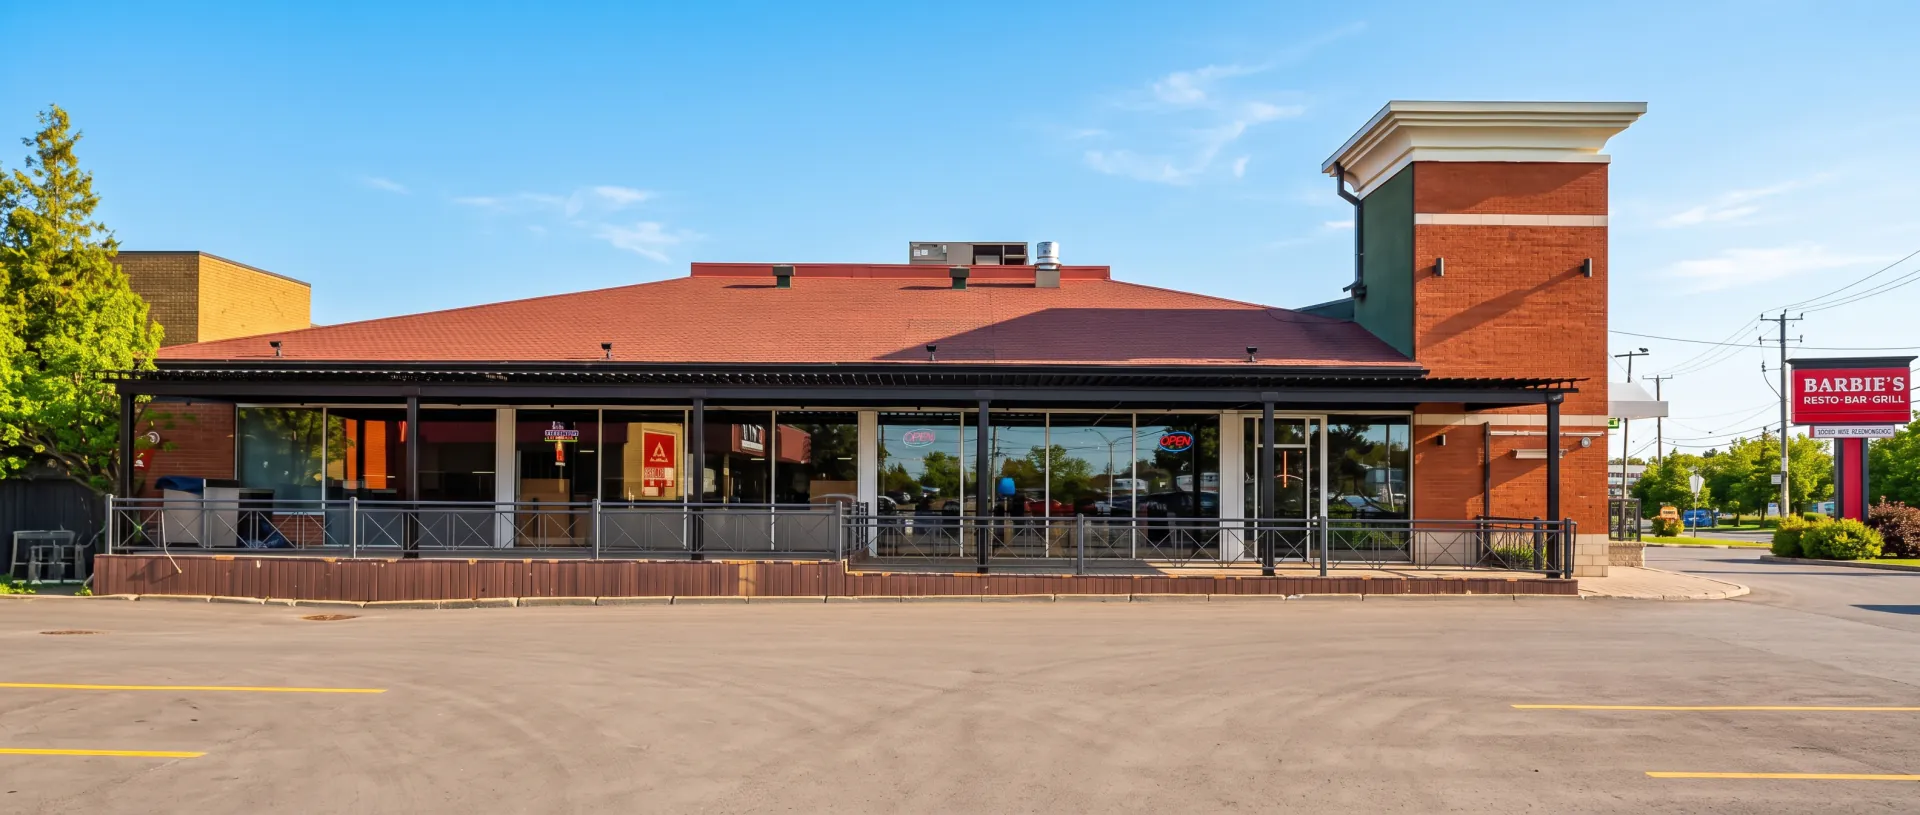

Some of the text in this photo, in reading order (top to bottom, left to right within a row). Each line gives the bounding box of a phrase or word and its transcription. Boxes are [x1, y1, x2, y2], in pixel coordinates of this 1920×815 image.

[1804, 377, 1905, 393] BARBIE'S
[904, 432, 935, 442] OPEN
[1160, 435, 1191, 446] OPEN
